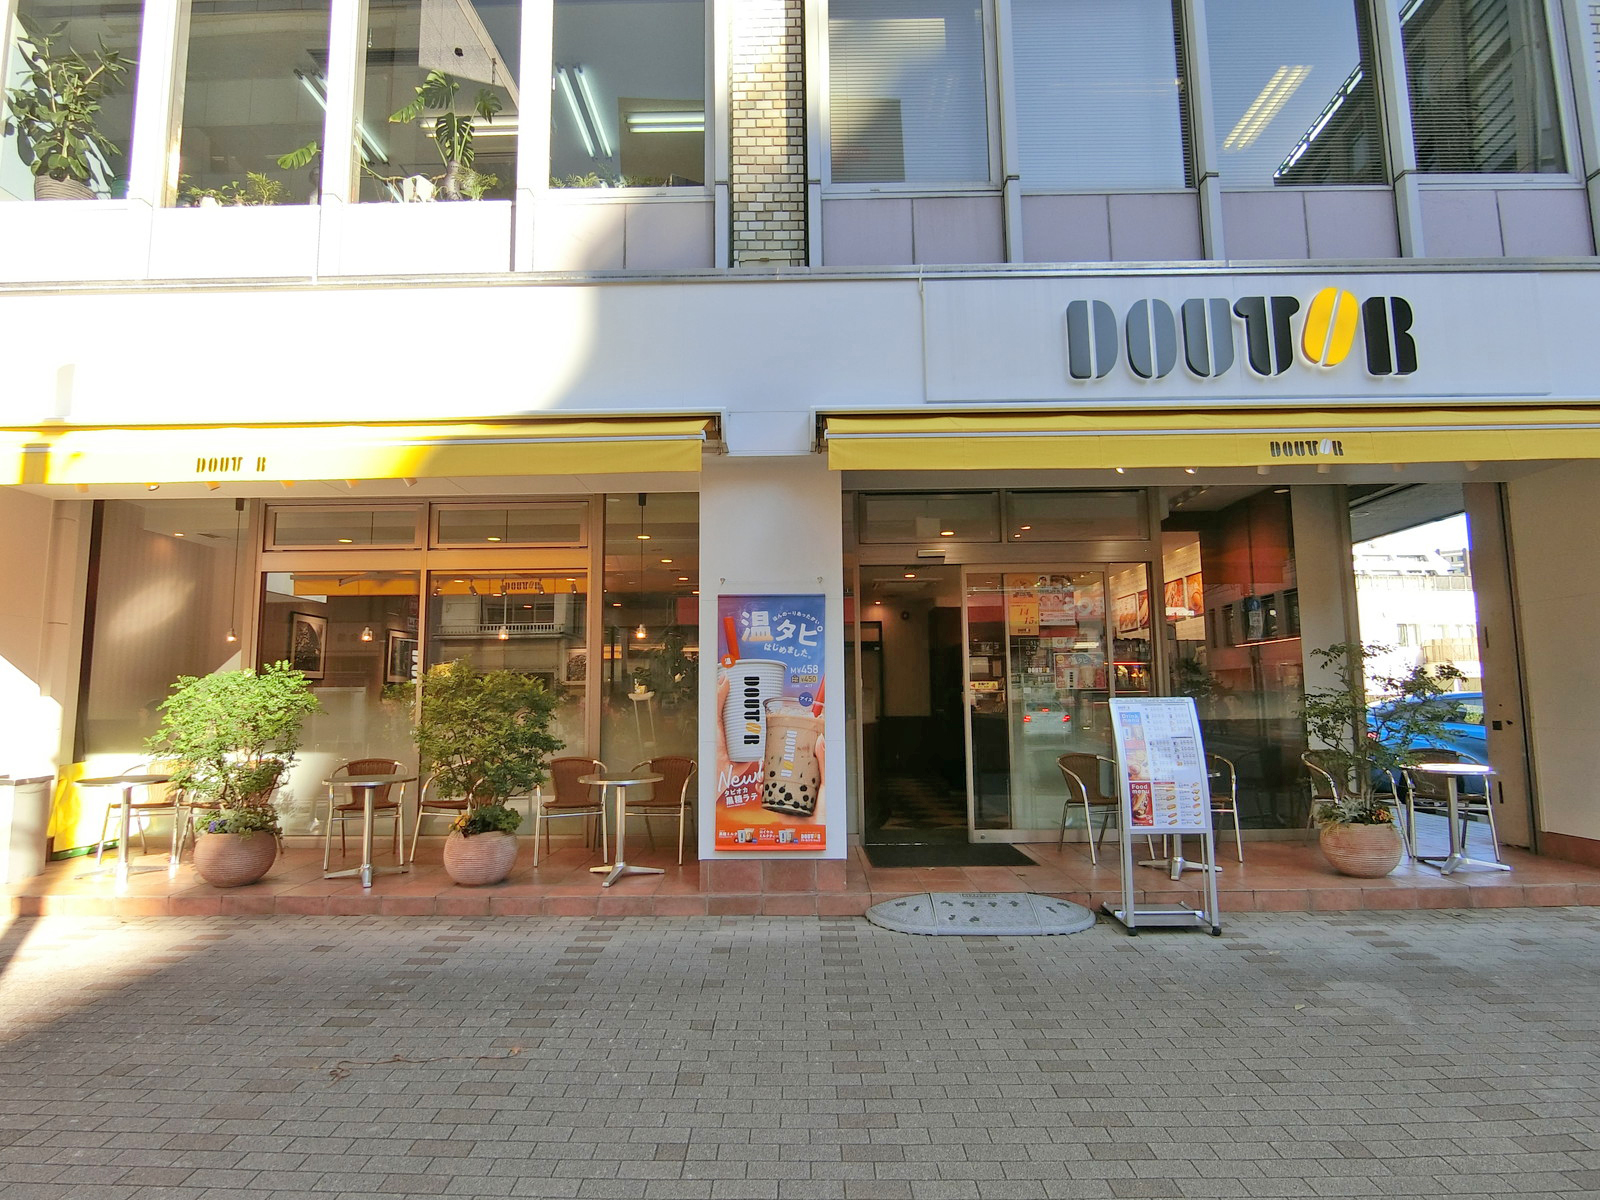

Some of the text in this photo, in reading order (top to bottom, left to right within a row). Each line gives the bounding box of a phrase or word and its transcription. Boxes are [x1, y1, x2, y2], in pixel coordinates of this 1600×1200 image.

[1066, 287, 1418, 379] DOUTOR
[196, 456, 266, 473] DOUTR
[1270, 439, 1344, 457] DOUTOR
[741, 611, 823, 646] 温タピ
[743, 676, 762, 745] DOUTOR
[780, 730, 797, 778] DOUTOR
